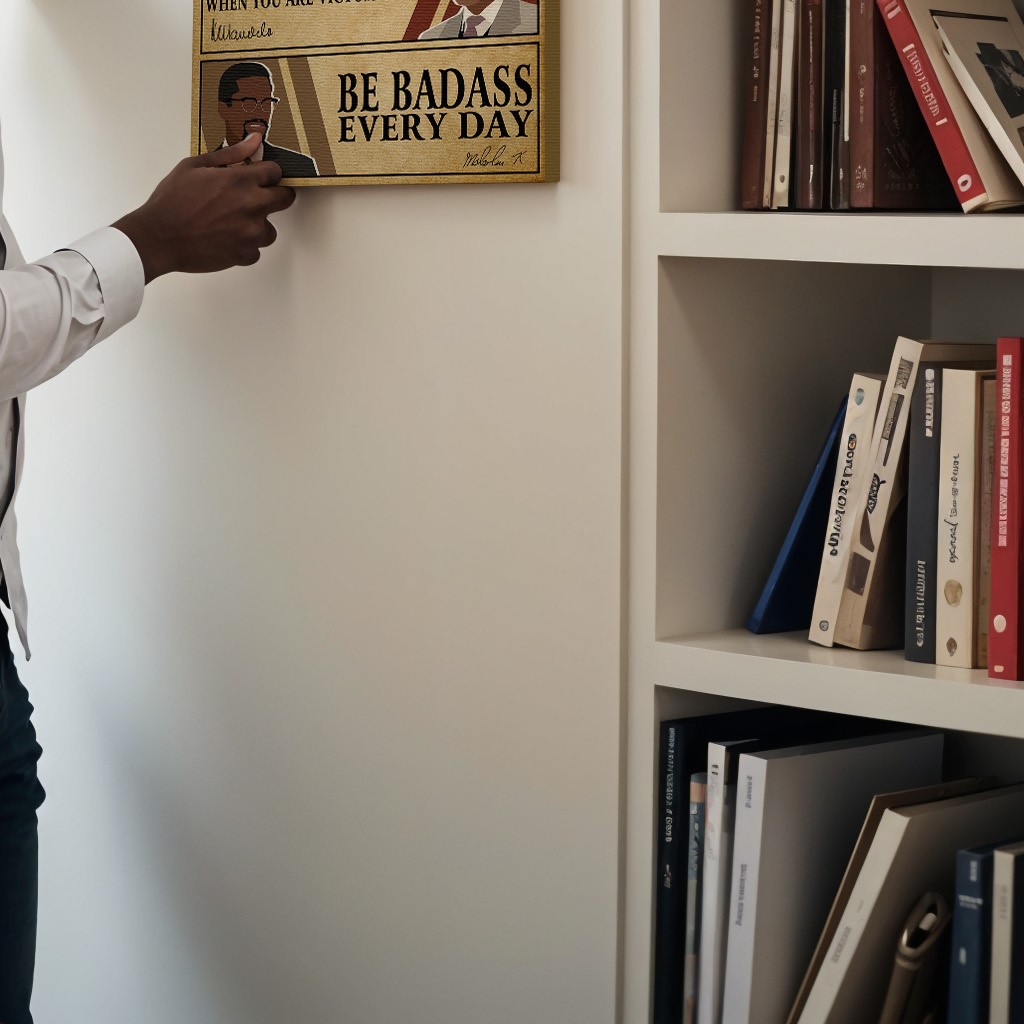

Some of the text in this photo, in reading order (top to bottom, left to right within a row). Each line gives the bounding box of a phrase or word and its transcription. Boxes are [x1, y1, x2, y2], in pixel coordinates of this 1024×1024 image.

[337, 63, 533, 114] BE BADASS
[337, 109, 535, 143] EVERY DAY
